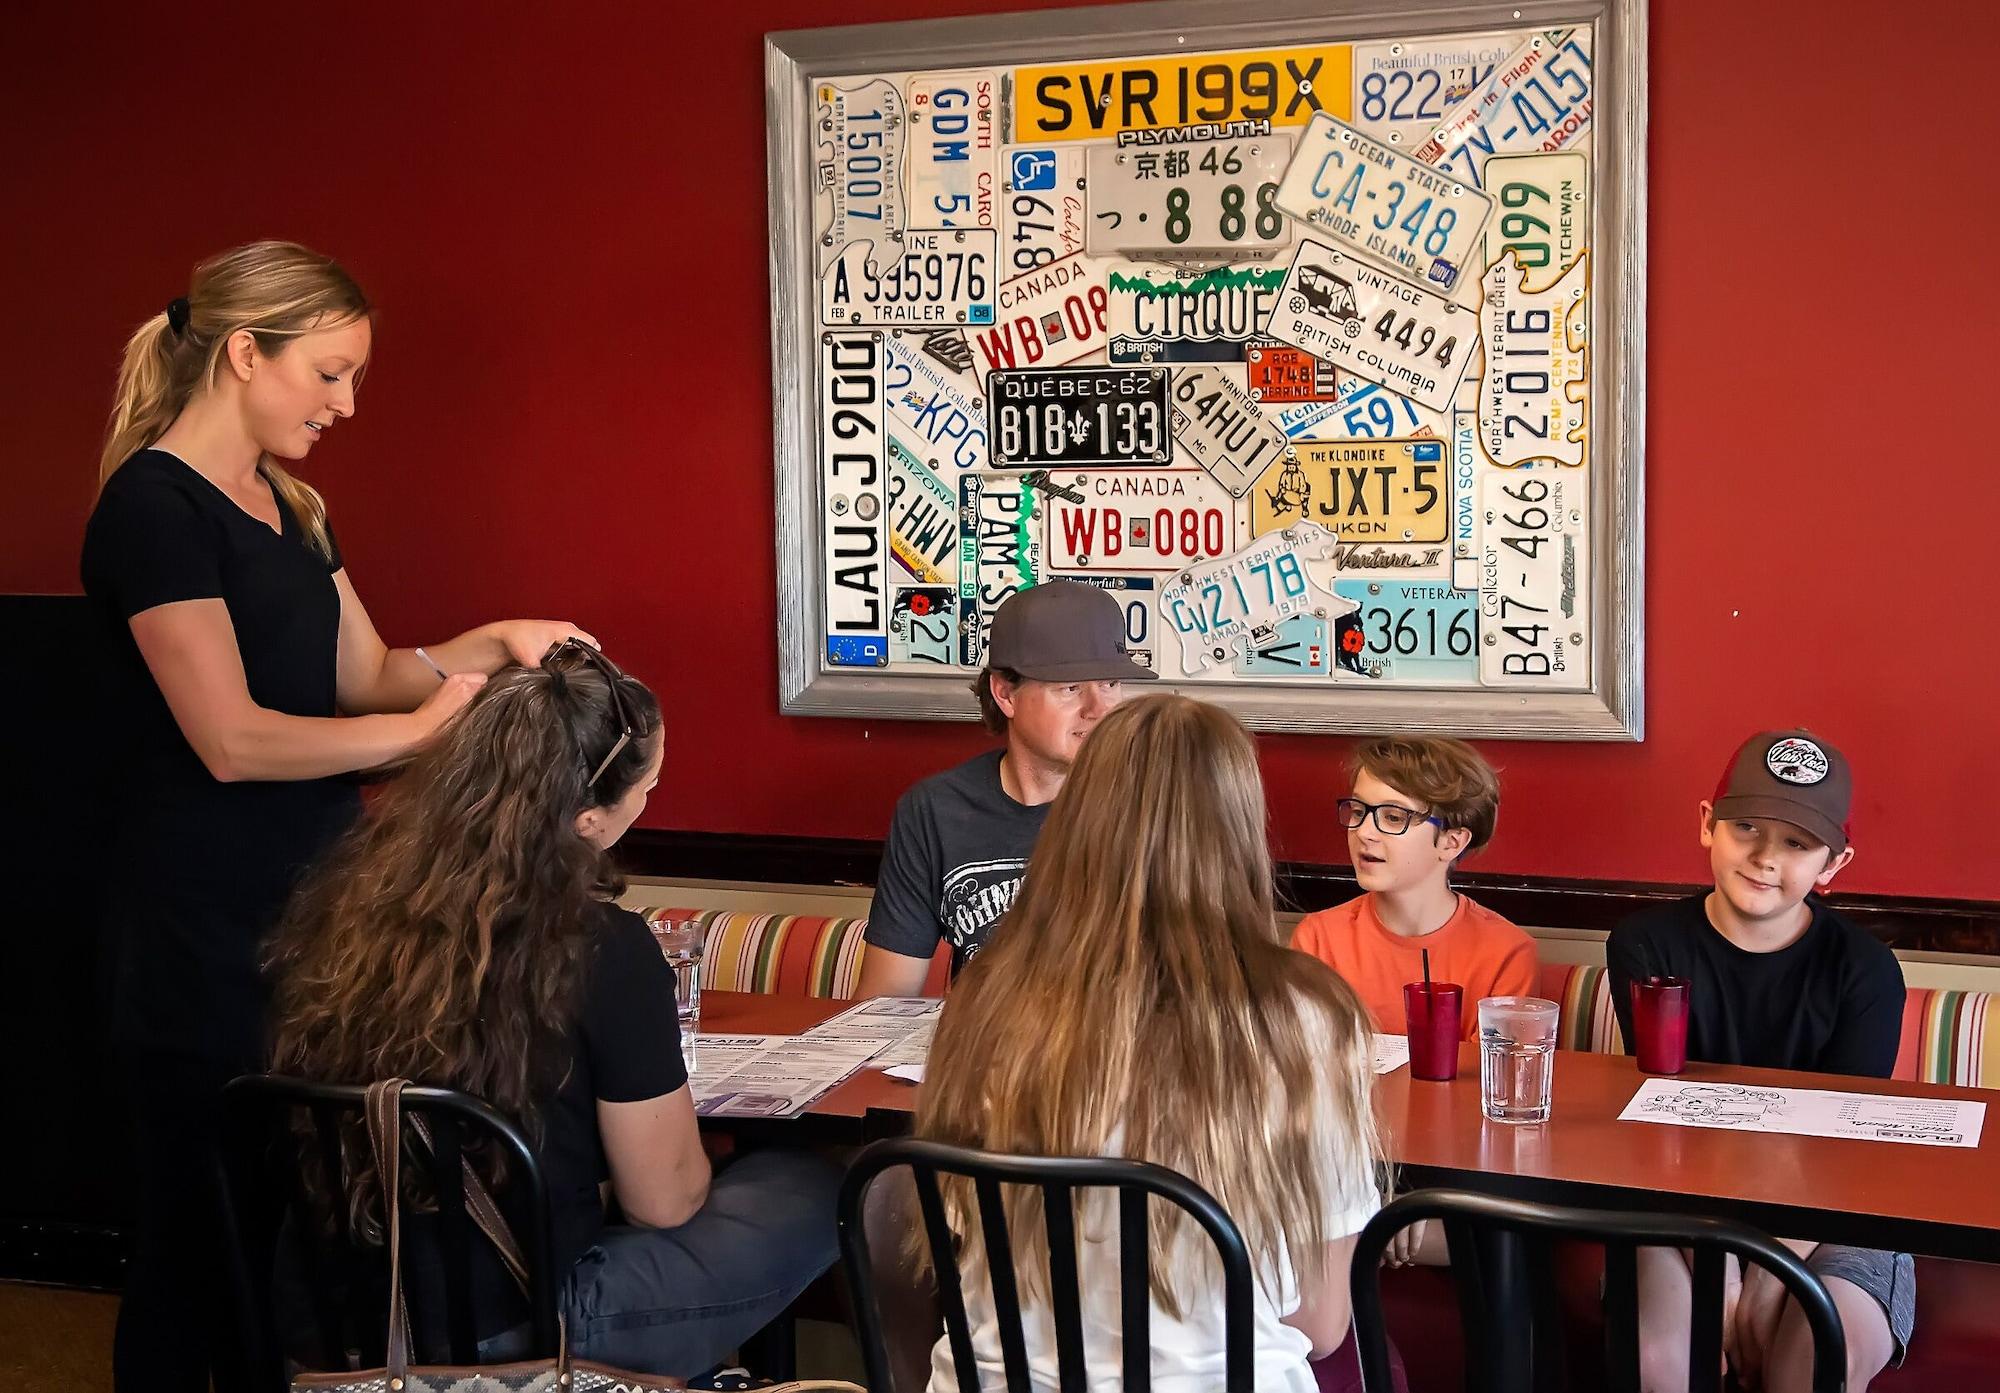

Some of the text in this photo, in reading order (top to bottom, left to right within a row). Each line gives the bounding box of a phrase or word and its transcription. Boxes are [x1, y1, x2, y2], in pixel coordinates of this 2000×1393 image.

[1372, 54, 1430, 71] Beautiful
[1434, 50, 1476, 67] British
[1501, 50, 1542, 88] Flight
[915, 94, 928, 105] 8
[1036, 57, 1323, 132] SVR 199X
[1362, 69, 1441, 121] 822
[1450, 69, 1465, 80] 17
[932, 88, 970, 161] GDM
[1117, 118, 1271, 147] PLYMOUTH
[1536, 99, 1592, 152] AROLI
[826, 170, 834, 181] 92
[847, 110, 882, 220] 15007
[977, 81, 992, 226] SOUTH CARO
[1135, 145, 1243, 180] 京都 46
[1350, 138, 1451, 198] OCEAN STATE
[1097, 211, 1122, 230] つ
[1312, 150, 1457, 257] CA-348
[910, 236, 938, 250] INE
[1317, 207, 1417, 269] RHODE ISLAND
[833, 256, 850, 303] A
[1000, 261, 1086, 309] CANADA
[1357, 268, 1423, 305] VINTAGE
[873, 305, 945, 320] TRAILER
[977, 315, 1044, 369] WB
[1064, 285, 1107, 341] 08
[1135, 290, 1273, 336] CIRQUE
[1126, 342, 1163, 352] BRITISH
[1273, 353, 1298, 364] ROE
[1292, 320, 1352, 354] BRITISH
[1357, 350, 1436, 393] COLUMBIA
[1374, 309, 1457, 369] 4494
[1492, 265, 1506, 456] NORTHWEST TERRITORIES
[914, 358, 945, 390] British
[1263, 366, 1311, 384] 1748
[1551, 299, 1564, 441] RCMP CENTENNIAL
[1568, 358, 1579, 375] 73
[1219, 376, 1263, 420] MANITOBA
[1261, 386, 1310, 397] HERRING
[914, 392, 986, 468] KPG
[1000, 401, 1161, 456] 818 133
[1176, 373, 1270, 467] 64HU1
[1192, 438, 1207, 455] MC
[1311, 449, 1385, 462] THE KLONDIKE
[890, 446, 956, 511] RIZONA
[1096, 478, 1185, 496] CANADA
[1459, 428, 1473, 539] NOVA SCOTIA
[1061, 508, 1224, 557] WB 080
[1319, 522, 1387, 534] UKON
[834, 526, 879, 630] LAU
[911, 553, 931, 576] CANYON
[963, 492, 977, 665] BRITISH JAN 93 COLUMBIA
[1164, 531, 1320, 602] NORTHWEST TERRITORIES
[1334, 543, 1418, 571] Ventura
[1551, 481, 1566, 672] British Columbia
[1401, 587, 1467, 600] VETERAN
[1483, 545, 1498, 618] Collector
[864, 638, 877, 657] D
[1202, 620, 1250, 646] CANADA
[1363, 658, 1391, 668] British
